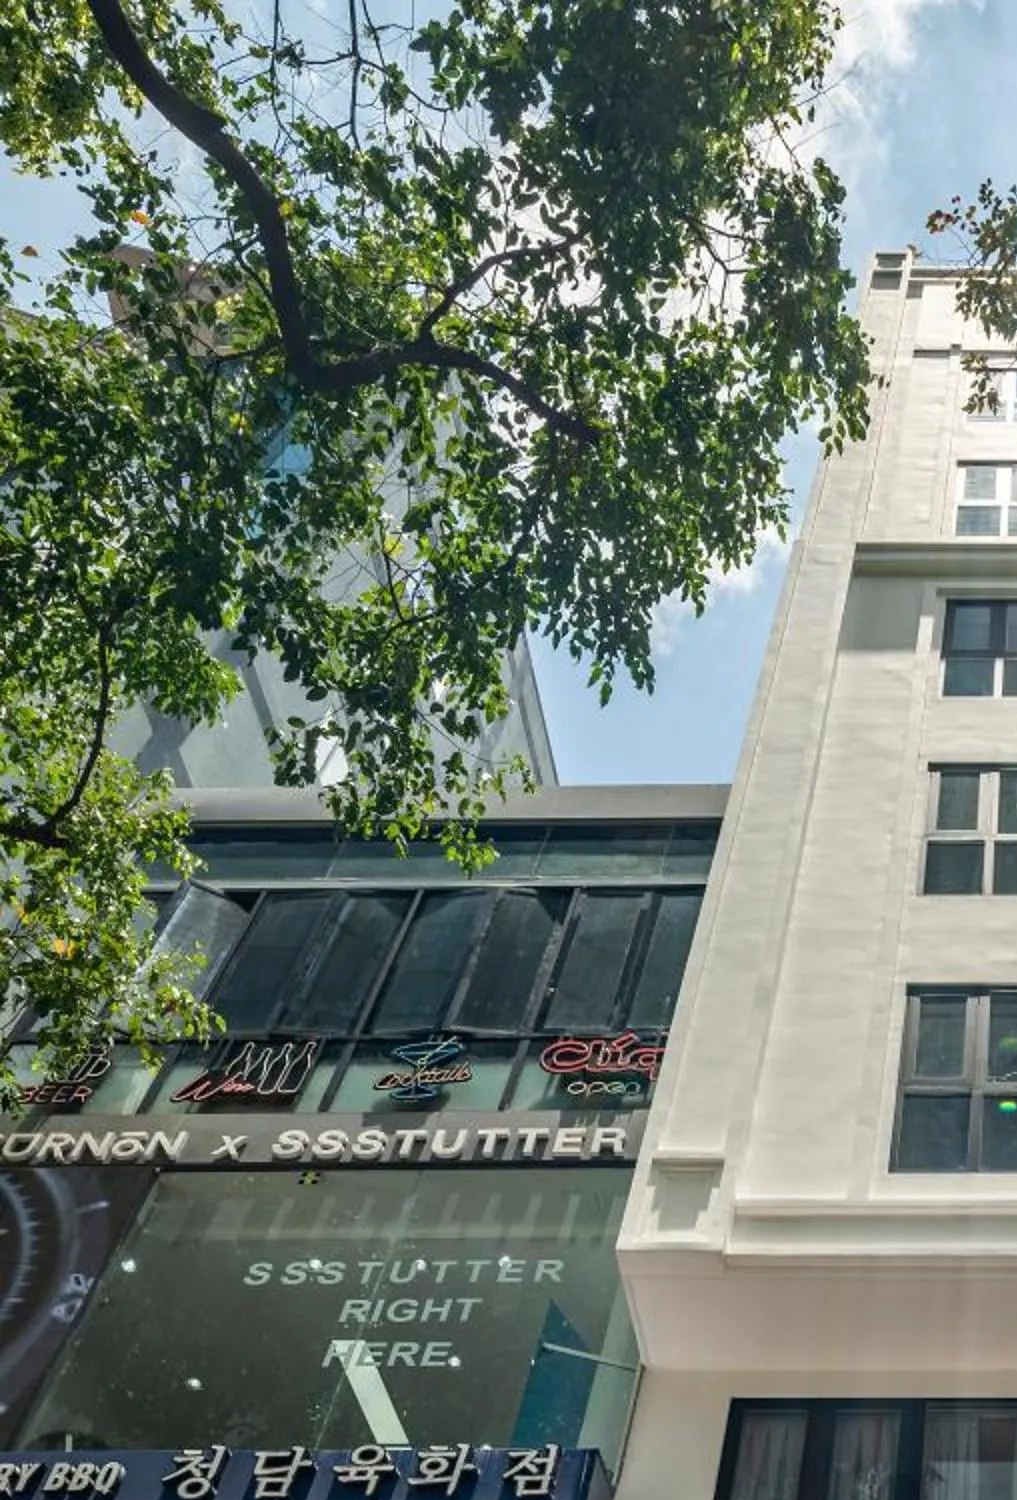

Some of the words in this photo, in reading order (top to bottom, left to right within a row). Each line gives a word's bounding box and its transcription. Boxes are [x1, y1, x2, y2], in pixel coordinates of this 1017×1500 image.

[271, 1127, 628, 1160] SSSTUTTER
[243, 1259, 565, 1286] SSSTUTTER
[337, 1298, 483, 1323] RIGHT
[43, 1461, 122, 1495] BBQ
[162, 1443, 558, 1500] 청담육화점
